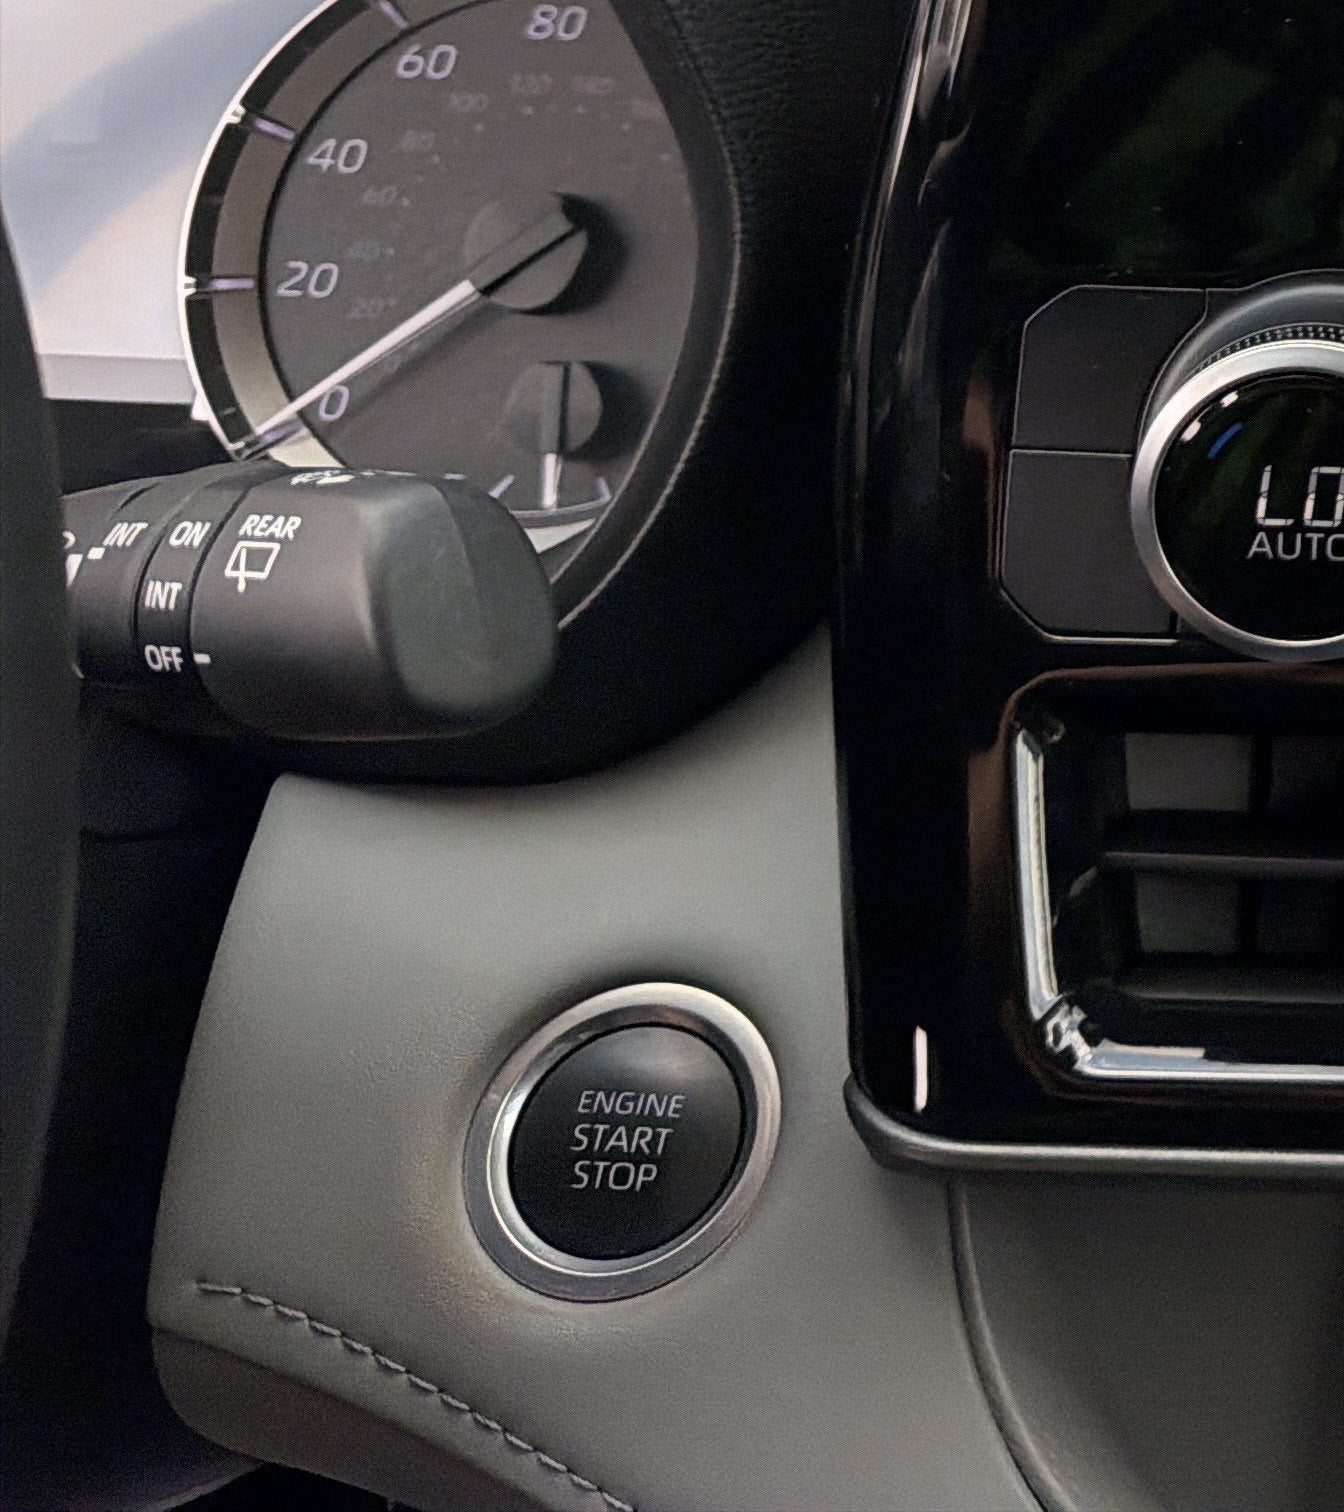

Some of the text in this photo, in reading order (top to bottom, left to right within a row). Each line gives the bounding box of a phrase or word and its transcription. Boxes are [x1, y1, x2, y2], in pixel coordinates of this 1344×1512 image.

[523, 3, 588, 42] 80
[396, 43, 458, 81] 60
[305, 138, 369, 175] 40
[276, 260, 340, 299] 20
[317, 384, 350, 422] 0
[103, 522, 149, 548] INT
[169, 521, 211, 549] ON
[238, 514, 302, 541] REAR
[144, 579, 184, 611] INT
[144, 644, 184, 672] OFF
[577, 1090, 686, 1118] ENGINE
[571, 1123, 674, 1156] START
[571, 1160, 658, 1192] STOP
